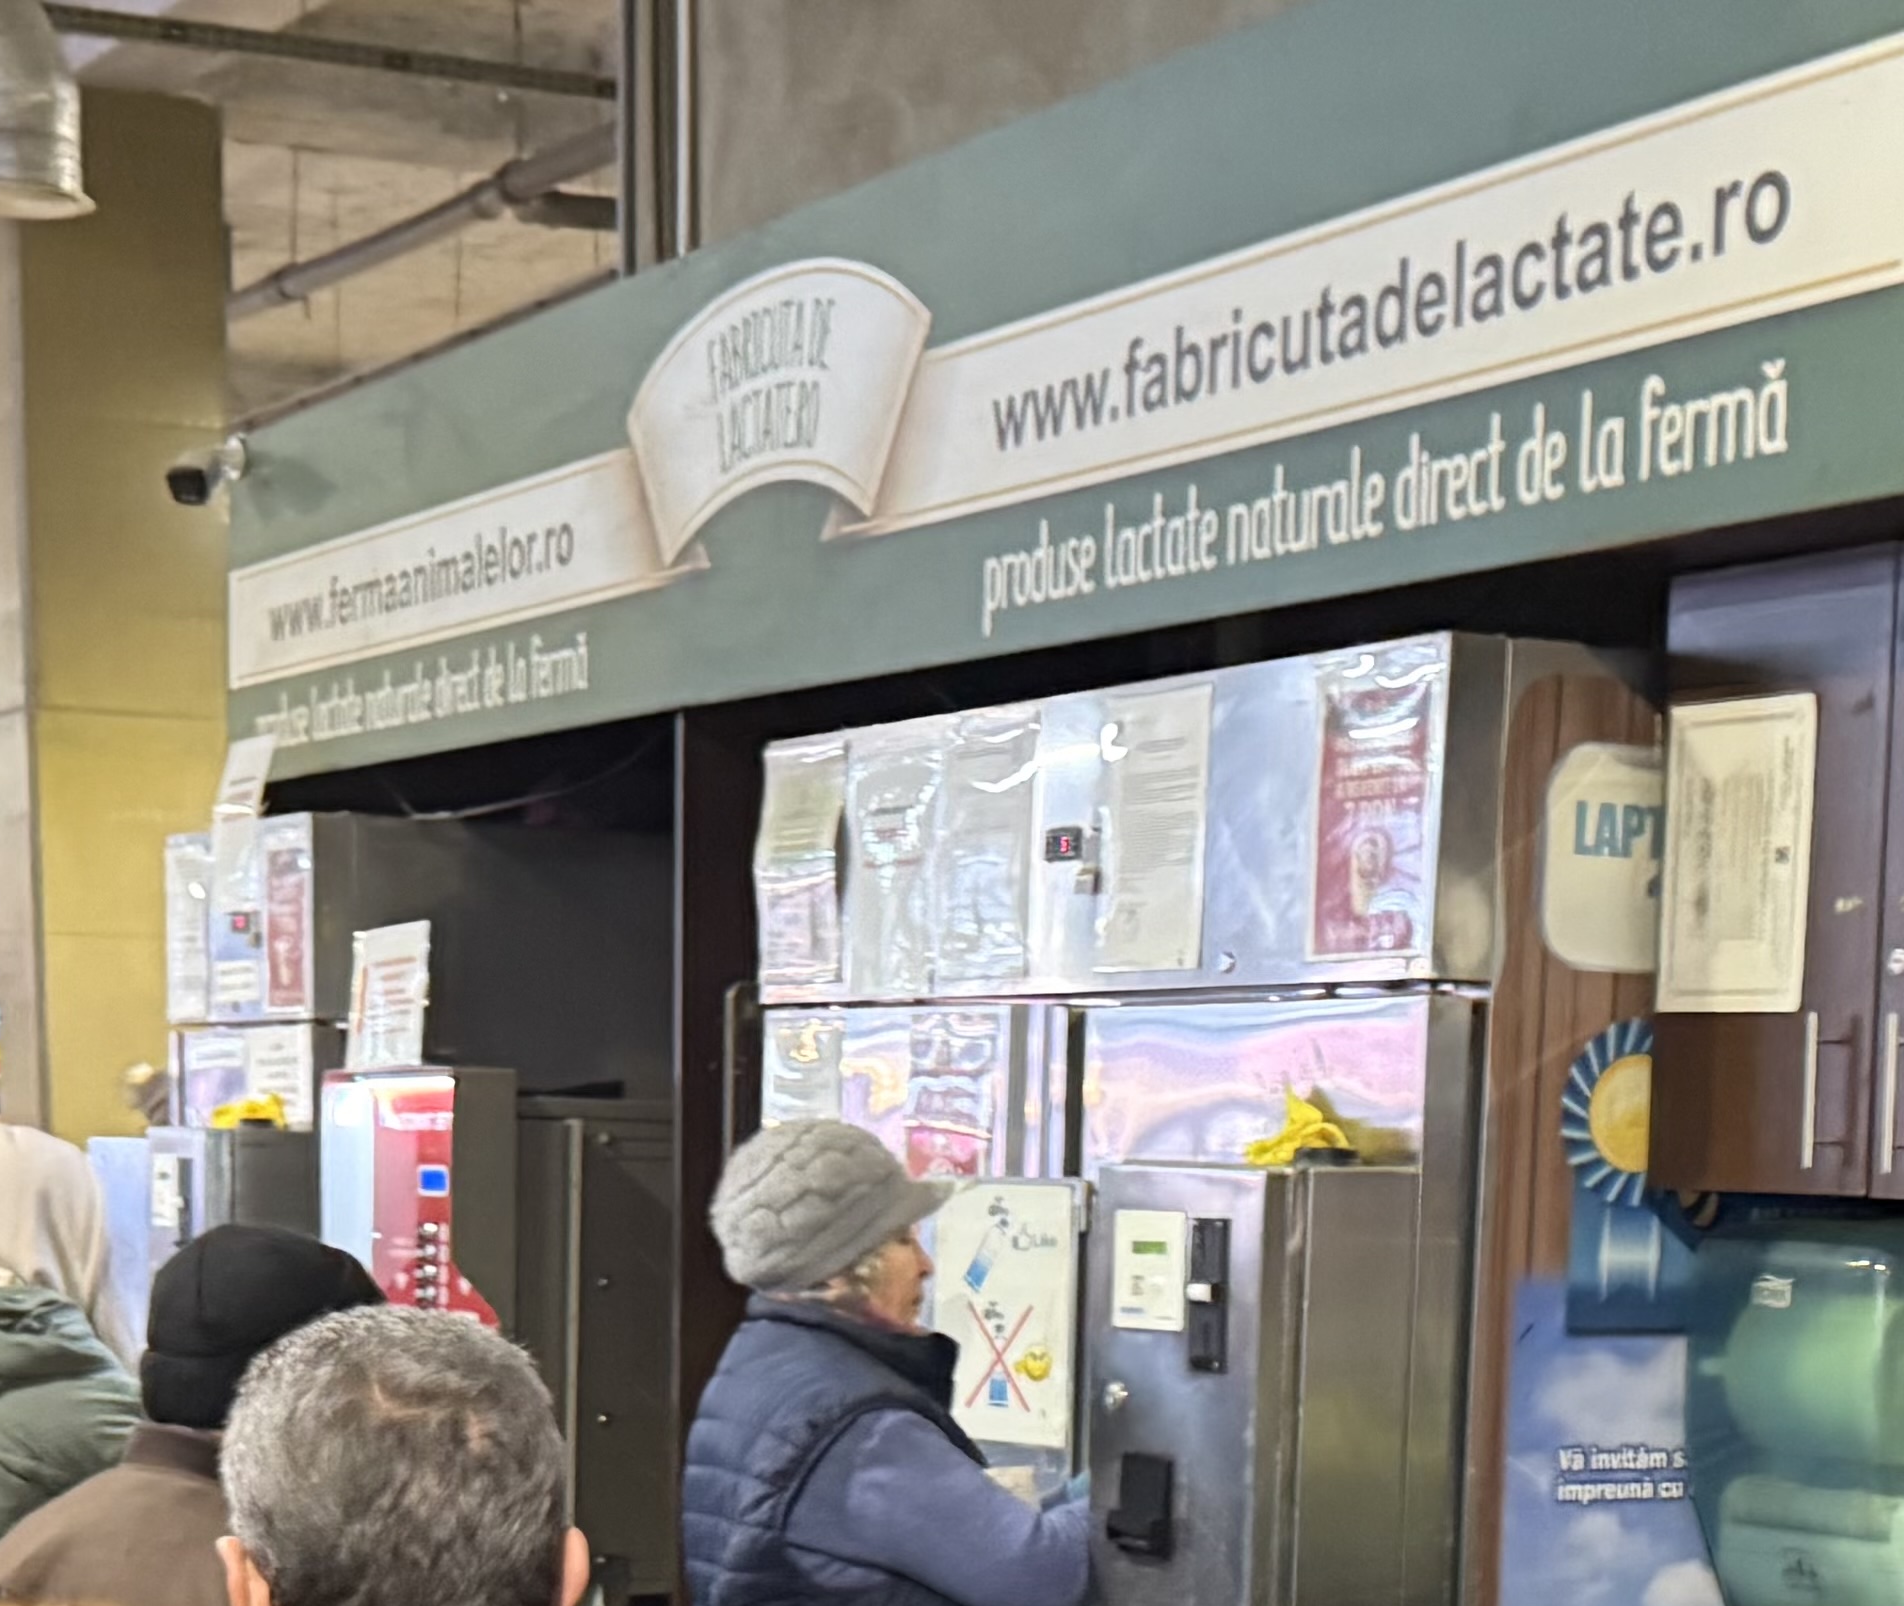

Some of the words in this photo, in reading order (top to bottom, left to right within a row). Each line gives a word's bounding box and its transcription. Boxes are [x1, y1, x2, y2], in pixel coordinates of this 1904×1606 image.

[991, 168, 1792, 453] www.fabricutadelactate.ro
[267, 522, 575, 642] www.fermaanimalelor.ro
[981, 518, 1096, 638] produse
[1103, 483, 1219, 590] lactate
[1226, 444, 1384, 568] naturale
[1393, 411, 1506, 535] direct
[1515, 402, 1566, 508] de
[1579, 388, 1625, 494] la
[1639, 358, 1789, 487] fermă
[311, 674, 363, 741] lactate
[365, 660, 433, 731] naturale
[434, 647, 481, 719] direct
[483, 640, 505, 709] de
[507, 639, 529, 702] la
[530, 631, 589, 699] fermă
